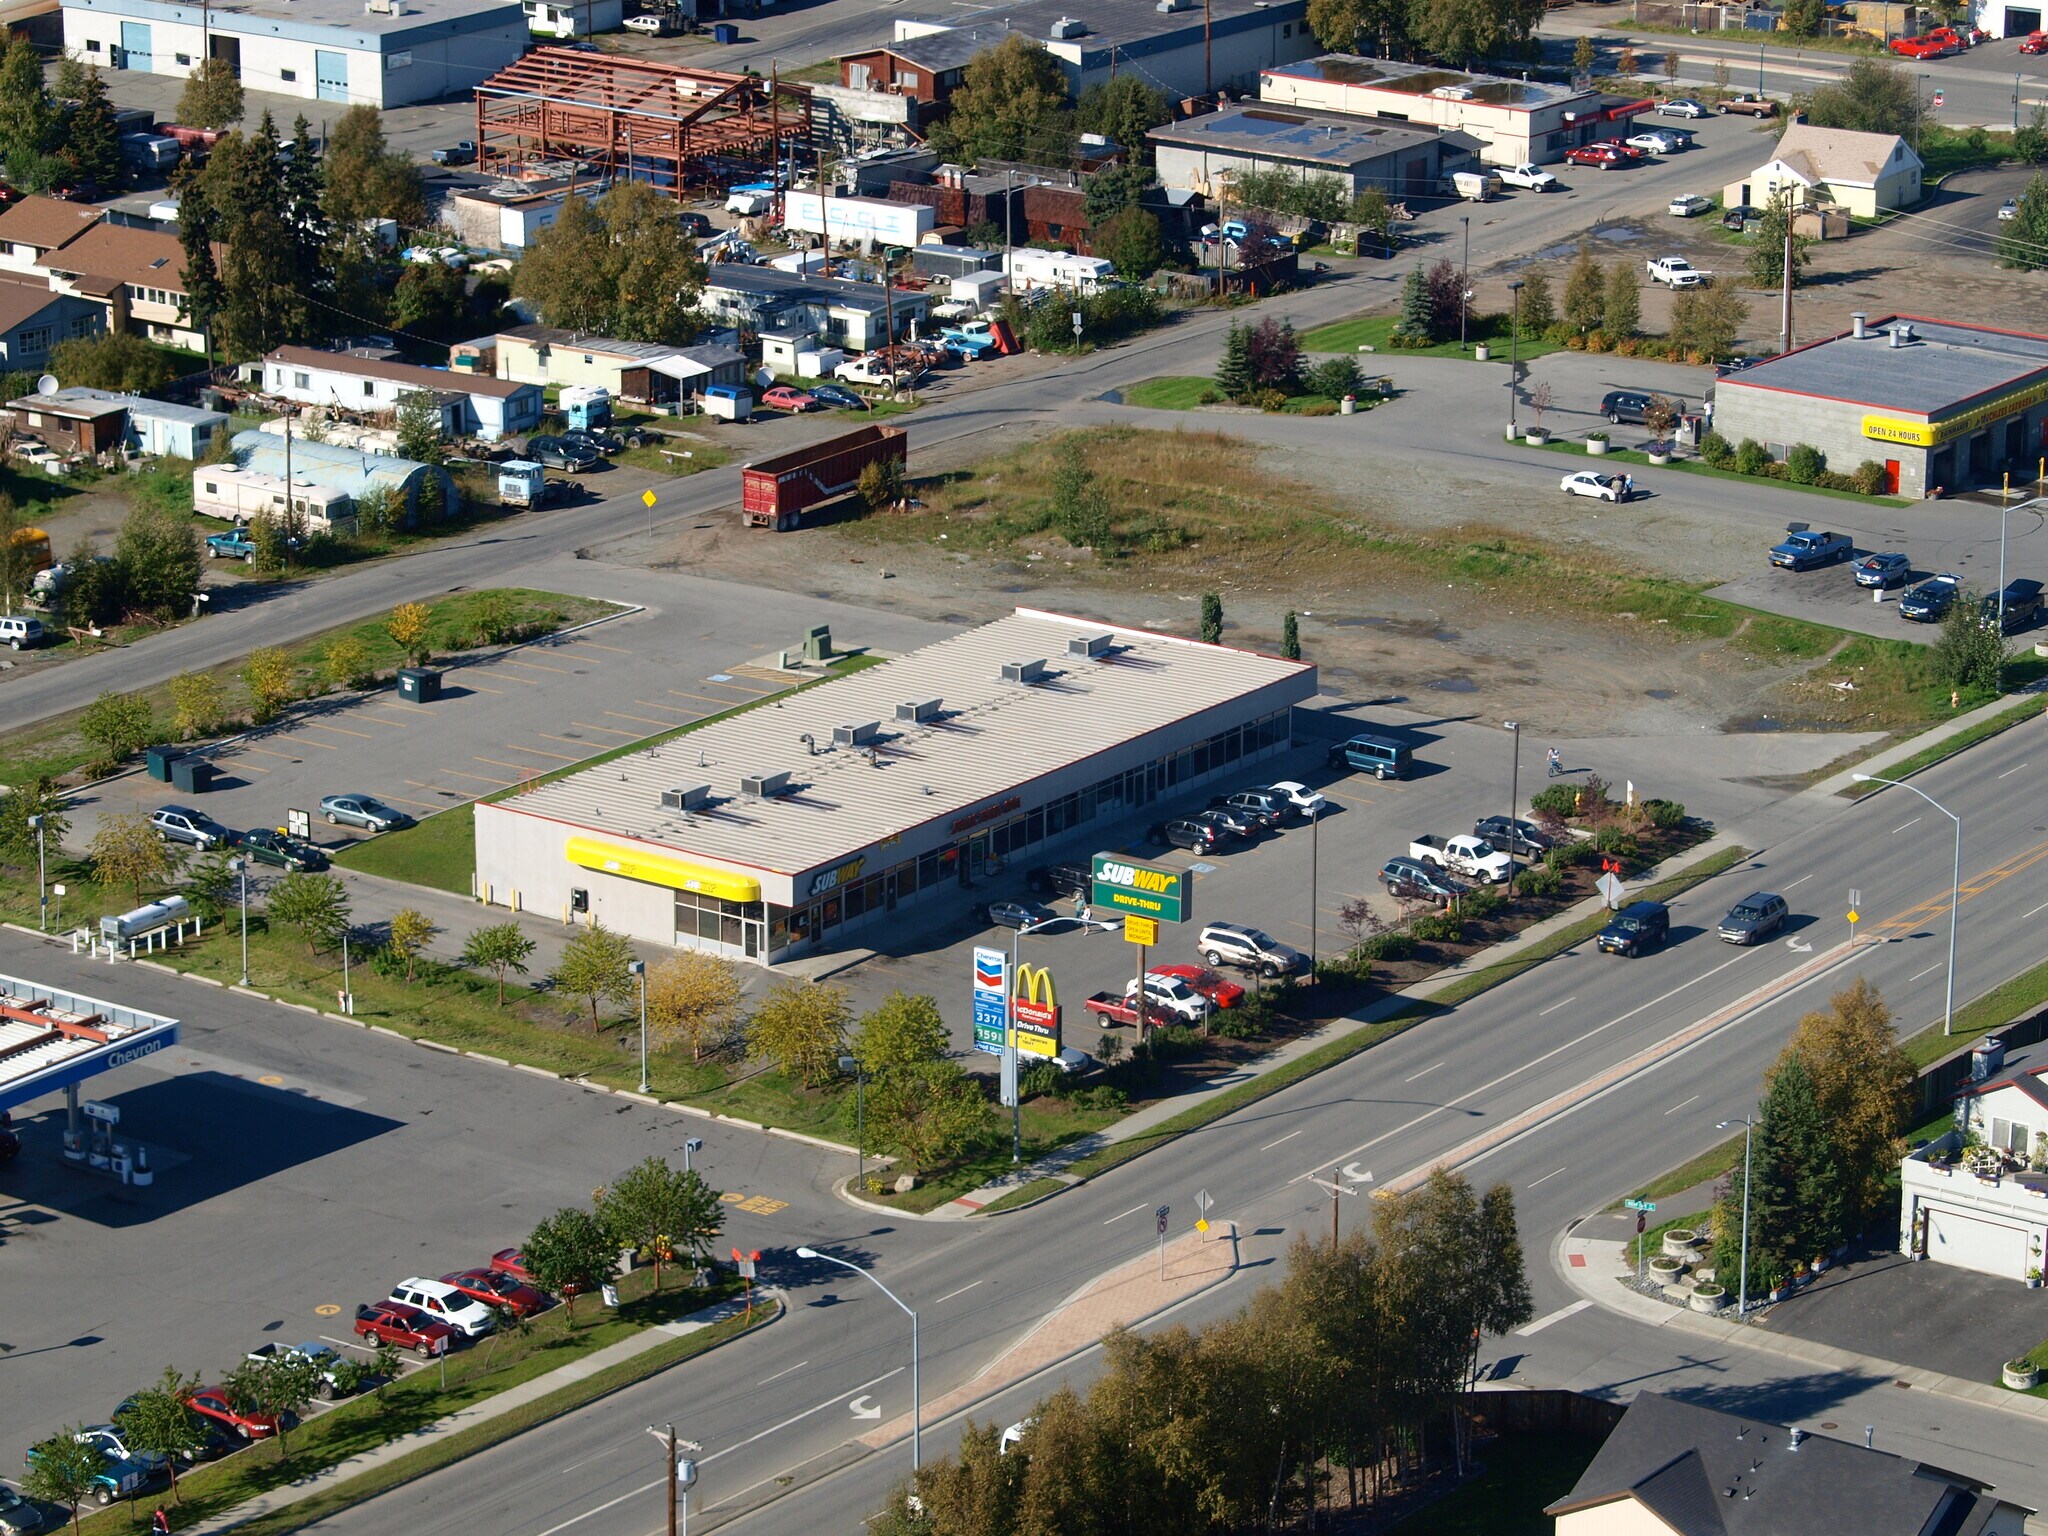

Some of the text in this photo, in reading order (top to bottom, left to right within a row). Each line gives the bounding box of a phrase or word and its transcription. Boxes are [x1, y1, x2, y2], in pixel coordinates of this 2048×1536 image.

[1981, 396, 2033, 424] TOUCHLESS CARWASH
[1868, 426, 1886, 436] OPEN
[1898, 431, 1921, 442] HOURS
[1940, 421, 1969, 438] RAINMAKER
[604, 860, 636, 874] SUBWAY
[811, 857, 866, 896] SUBWAY
[1097, 862, 1177, 893] SUBWAY
[685, 879, 718, 893] SUBWAY
[1113, 893, 1161, 911] DRIVE-THRU
[976, 951, 1003, 963] Chevron
[976, 1012, 998, 1025] 337
[1017, 1020, 1050, 1035] Drive Thru
[108, 1039, 161, 1068] Chevron
